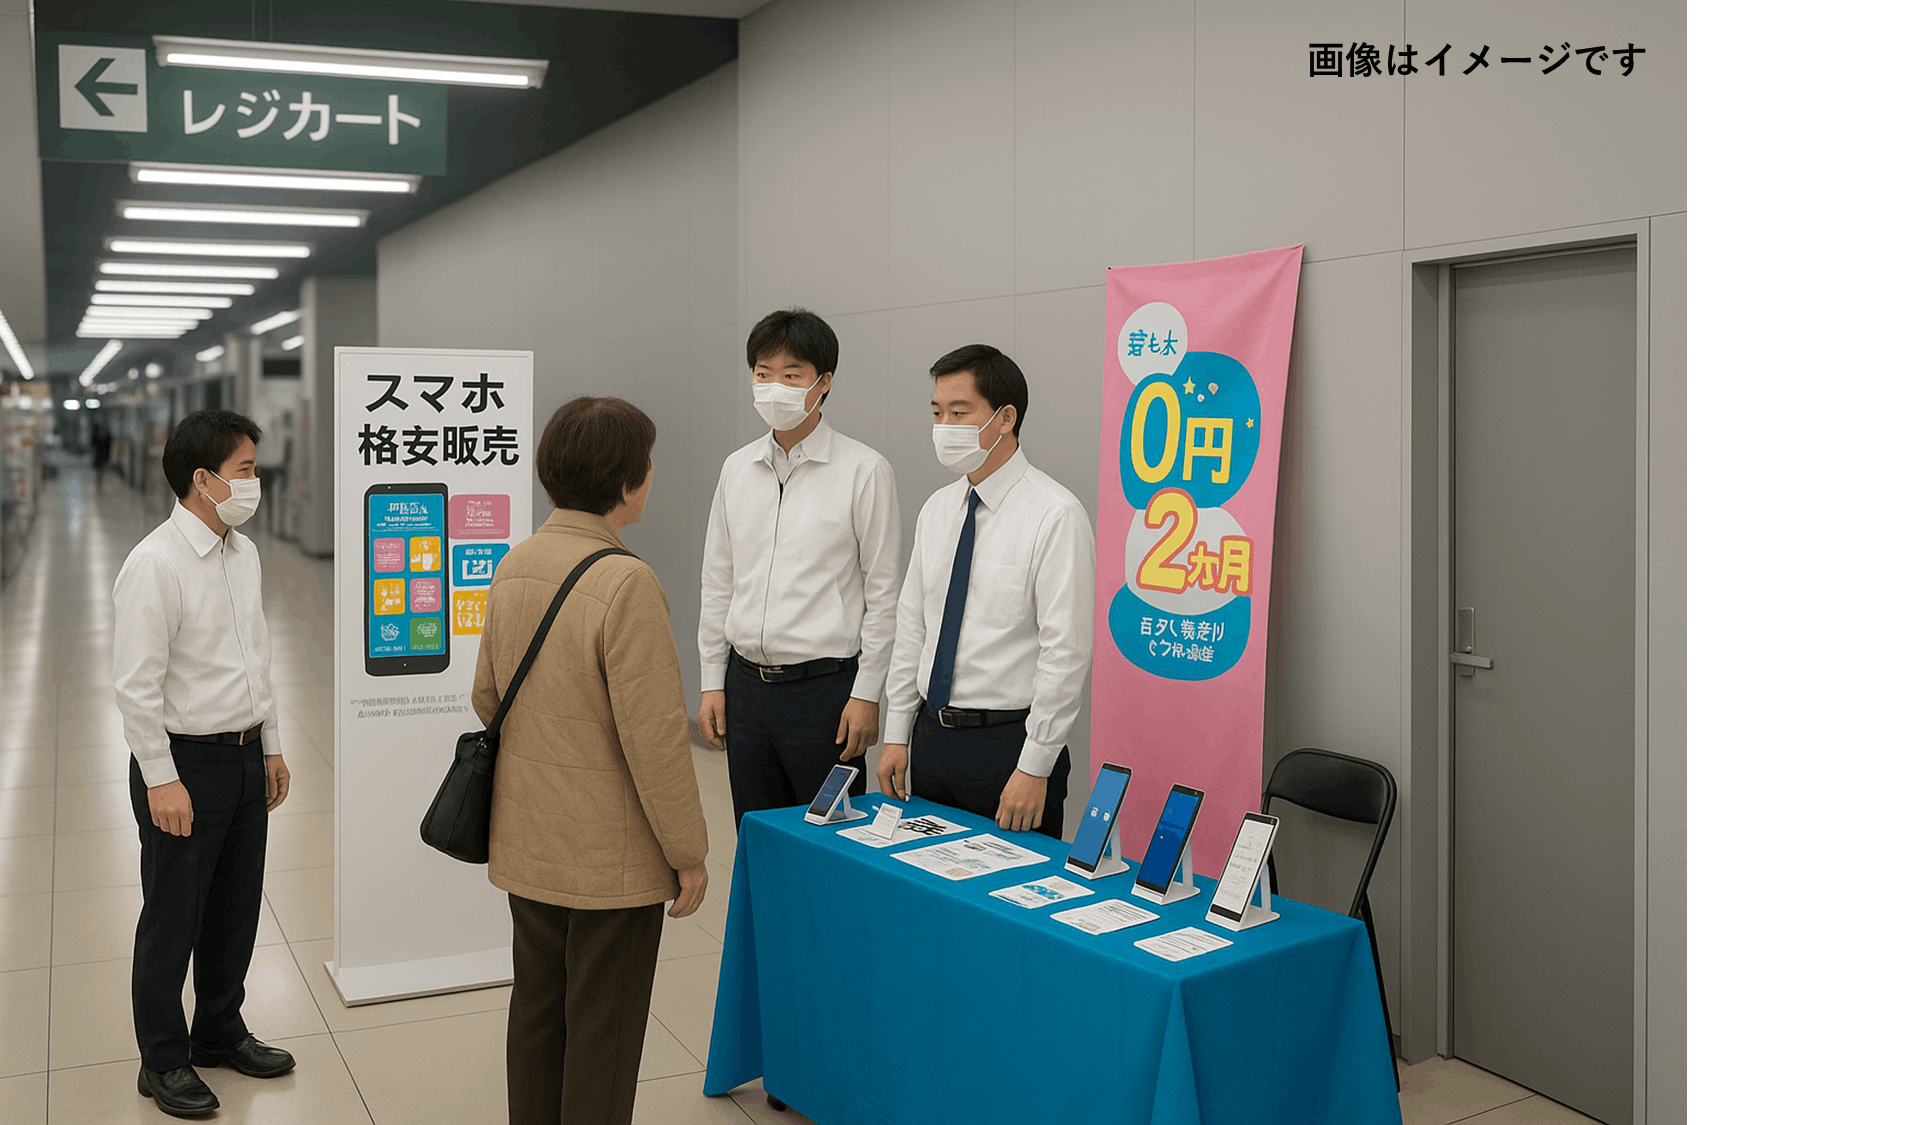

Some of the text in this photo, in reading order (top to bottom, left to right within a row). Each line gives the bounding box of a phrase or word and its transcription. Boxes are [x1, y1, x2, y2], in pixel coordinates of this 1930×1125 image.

[182, 88, 421, 146] レジカート
[364, 372, 506, 414] スマホ
[1130, 381, 1234, 484] 0円
